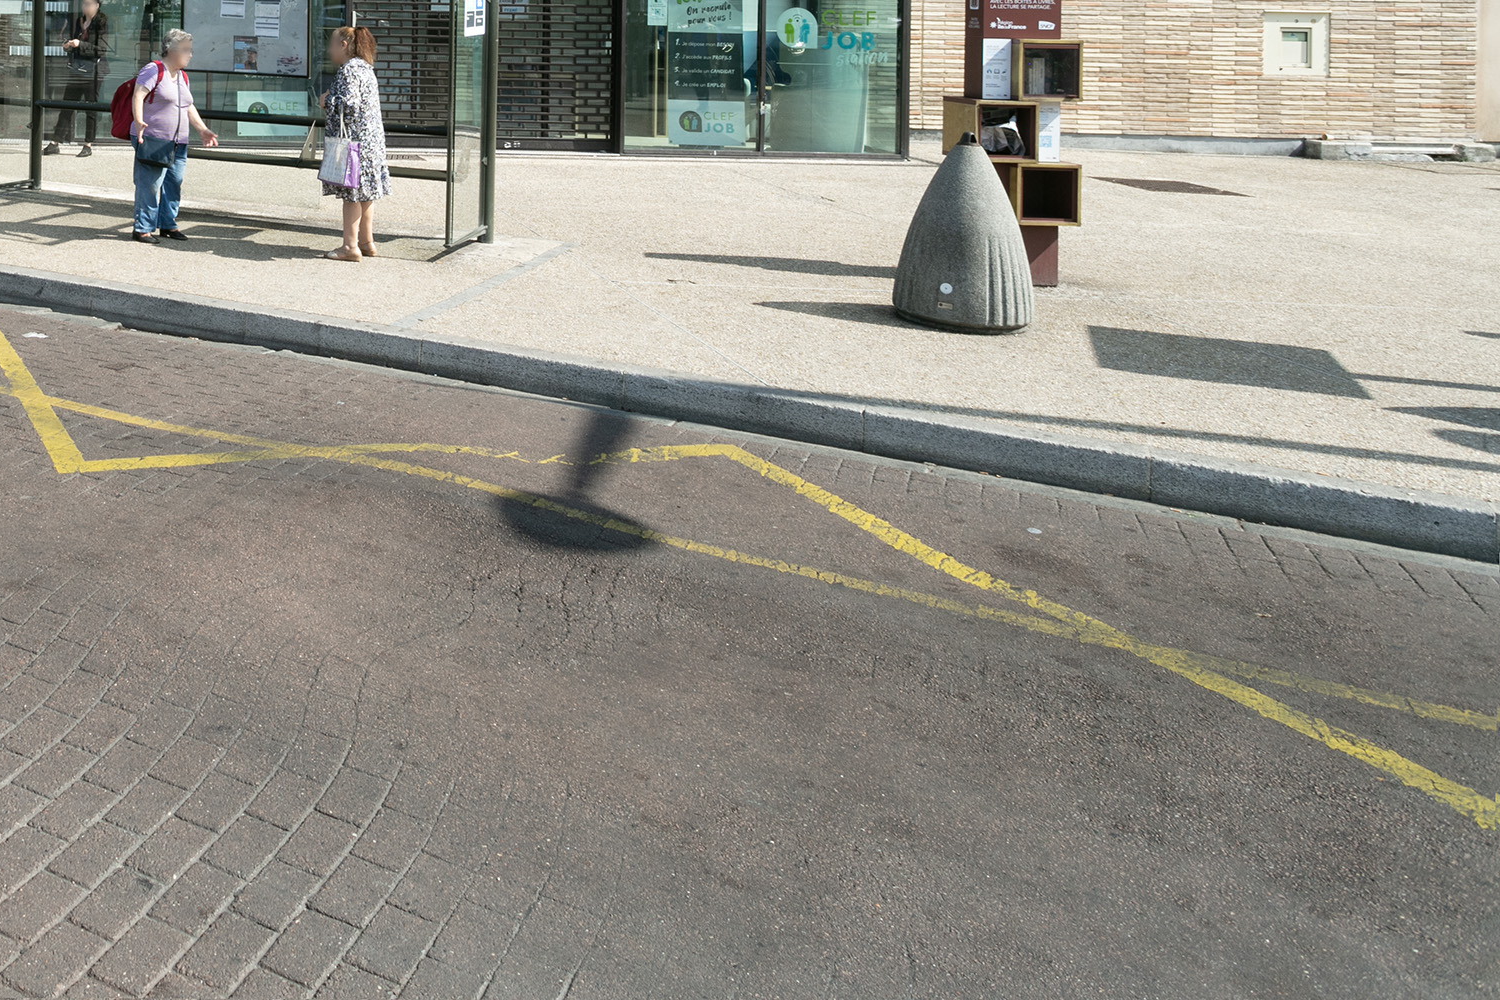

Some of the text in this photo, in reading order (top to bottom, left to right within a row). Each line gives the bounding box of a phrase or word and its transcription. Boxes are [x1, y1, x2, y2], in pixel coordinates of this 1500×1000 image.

[687, 1, 731, 15] On recrute
[688, 18, 705, 27] pour
[708, 15, 726, 23] vous
[821, 10, 876, 26] CLEF
[822, 31, 876, 50] JOB
[836, 51, 888, 67] station
[270, 102, 298, 111] CLEF
[703, 112, 735, 120] CLEF
[704, 123, 735, 133] JOB
